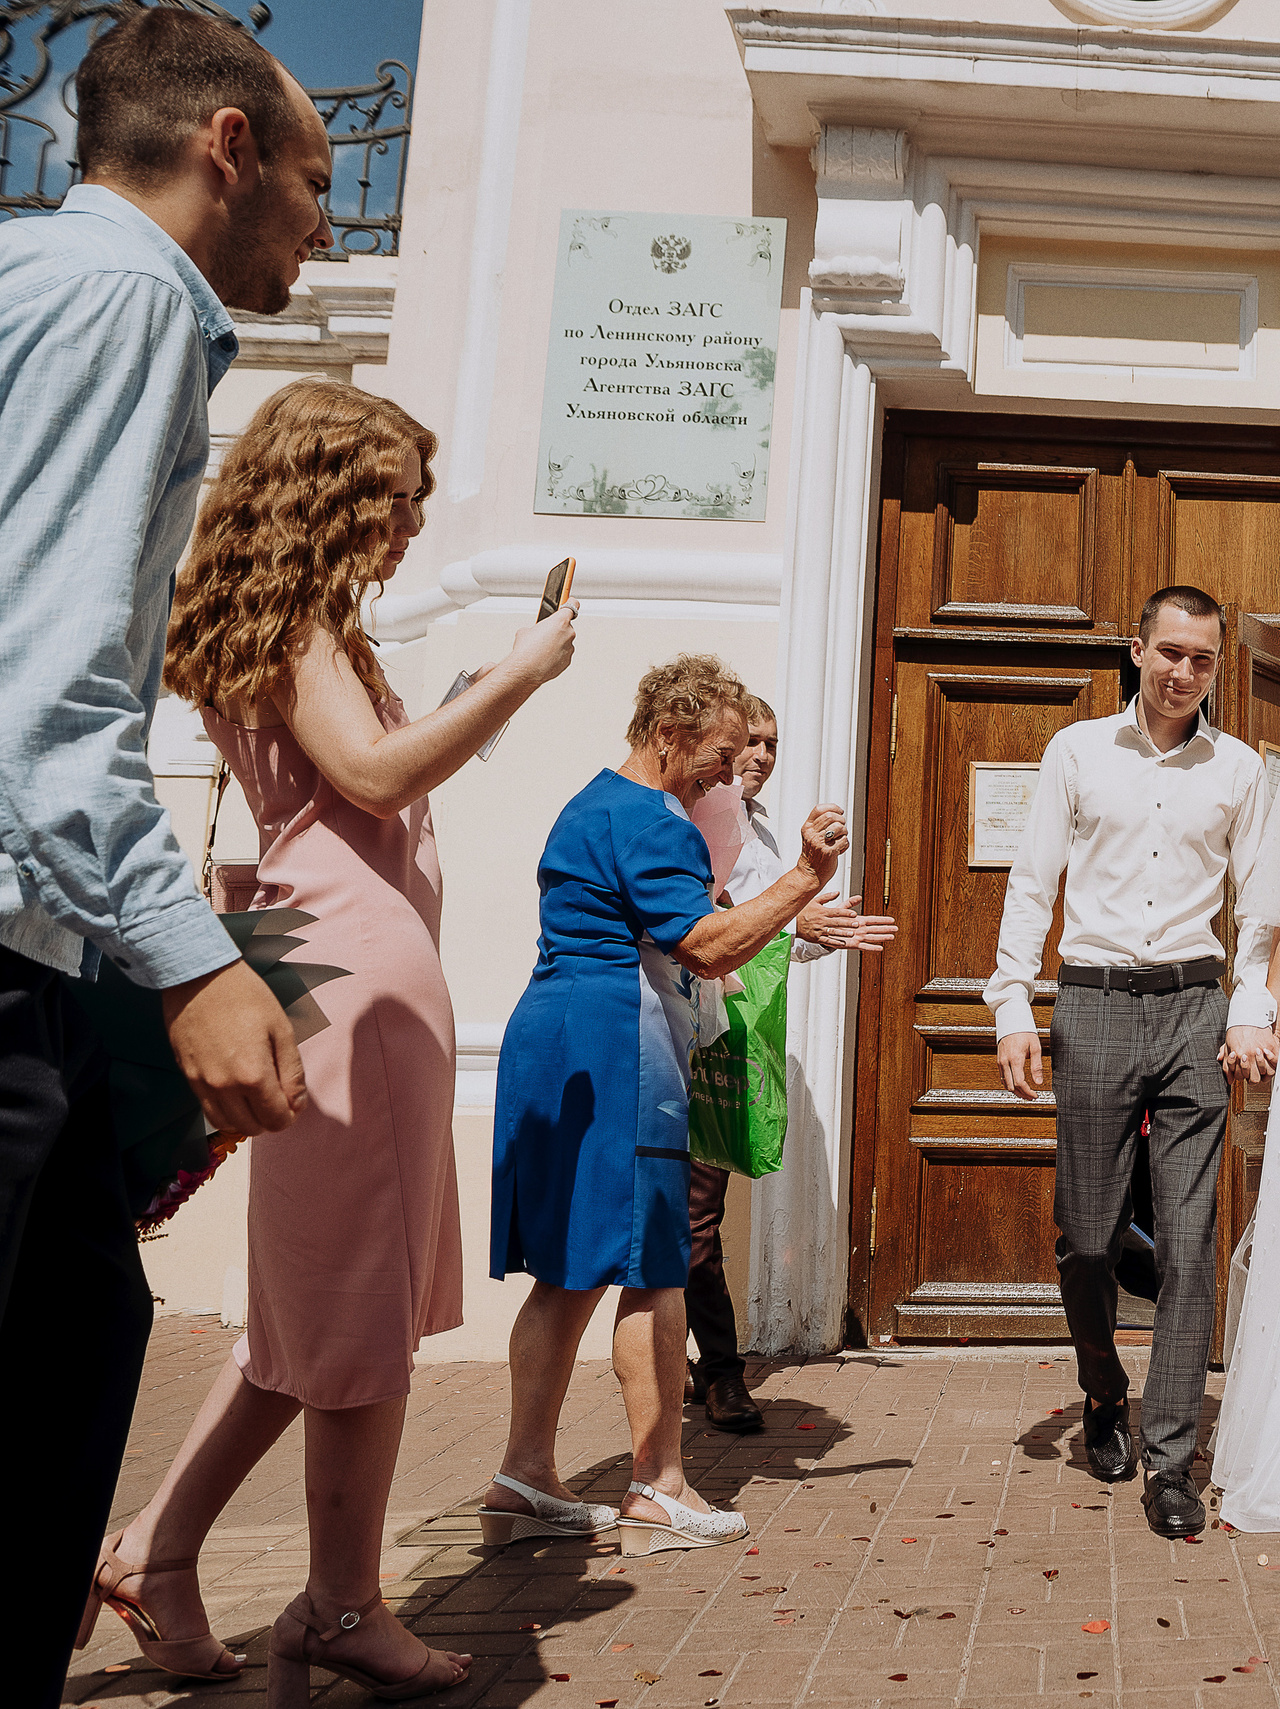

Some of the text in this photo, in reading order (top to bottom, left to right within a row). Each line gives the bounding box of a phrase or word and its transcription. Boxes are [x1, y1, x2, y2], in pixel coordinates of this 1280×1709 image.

[609, 299, 723, 318] Отдел ЗАГС
[564, 324, 762, 349] по Ленинскому району
[580, 353, 742, 372] города Ульяновска
[583, 377, 734, 399] Агентства ЗАГС
[566, 403, 748, 426] Ульяновской области
